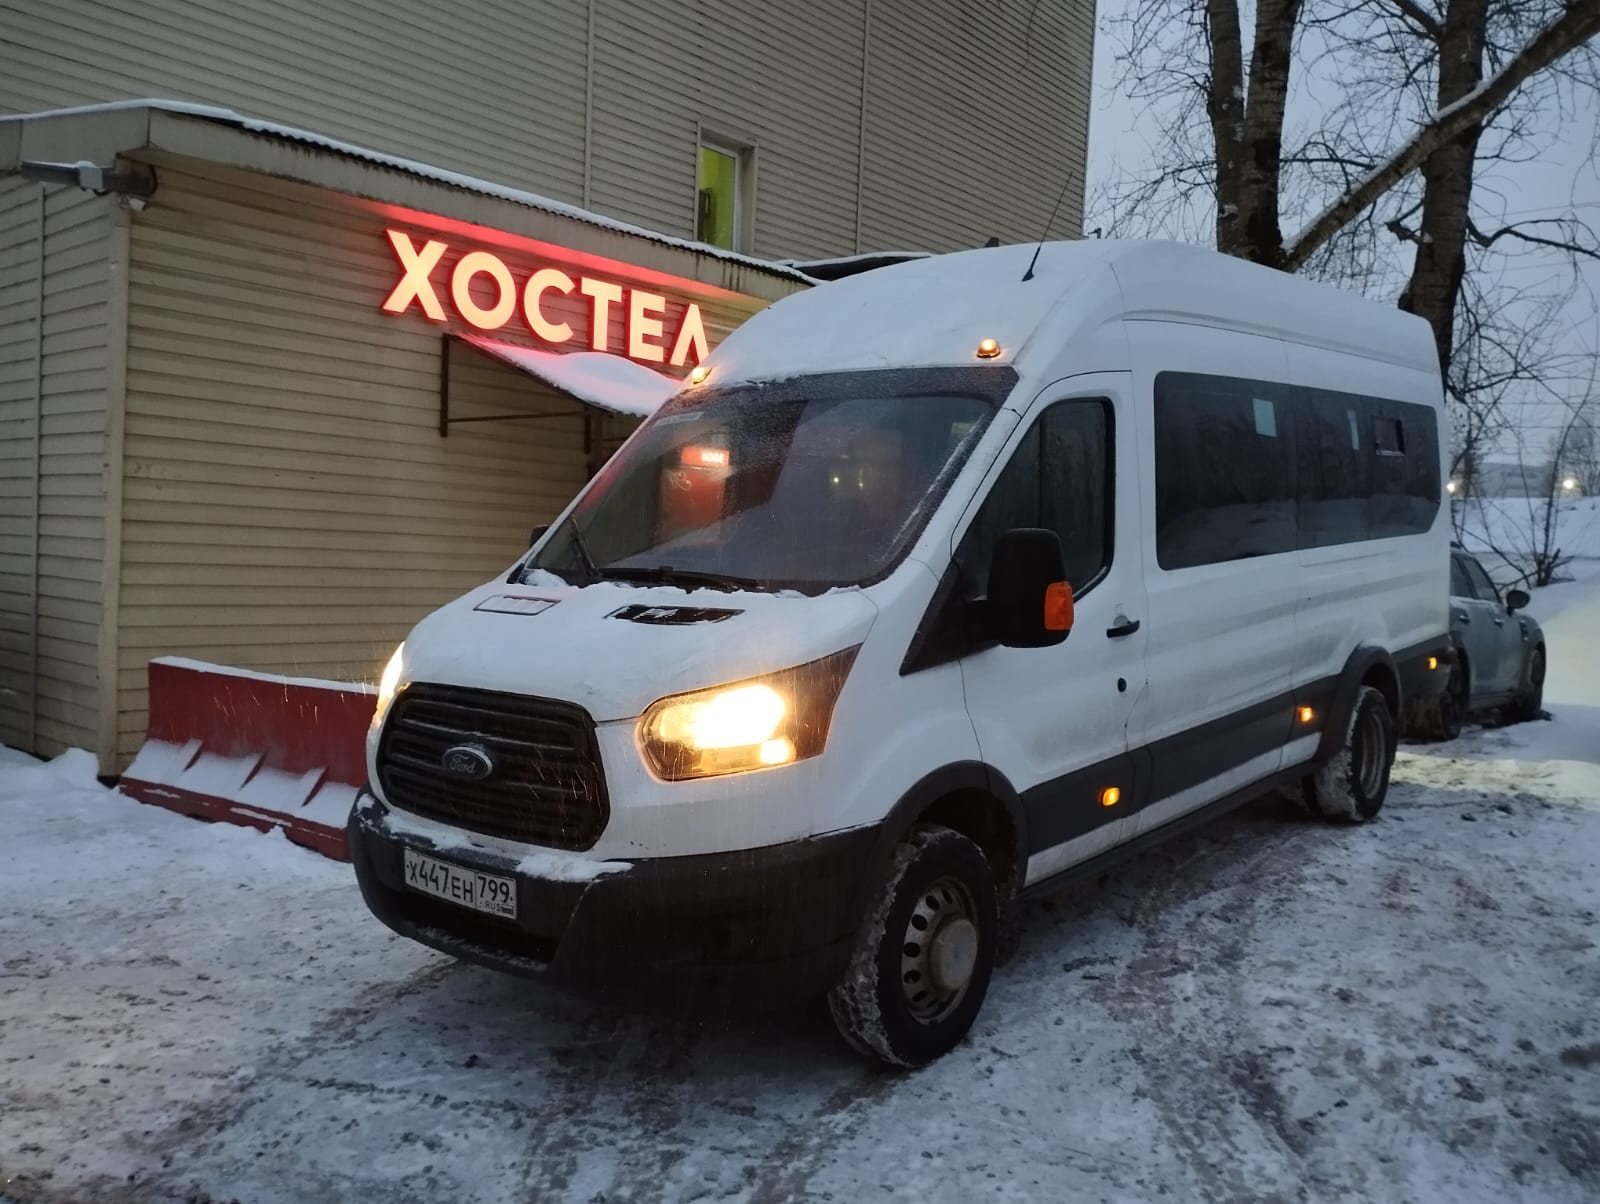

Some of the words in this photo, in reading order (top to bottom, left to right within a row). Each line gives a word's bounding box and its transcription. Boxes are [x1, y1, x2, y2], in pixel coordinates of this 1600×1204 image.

[382, 229, 709, 366] ХОСТЕЛ
[450, 754, 476, 773] Ford
[409, 860, 473, 903] Х447ЕН
[478, 876, 510, 903] 799
[485, 901, 502, 912] RUS
